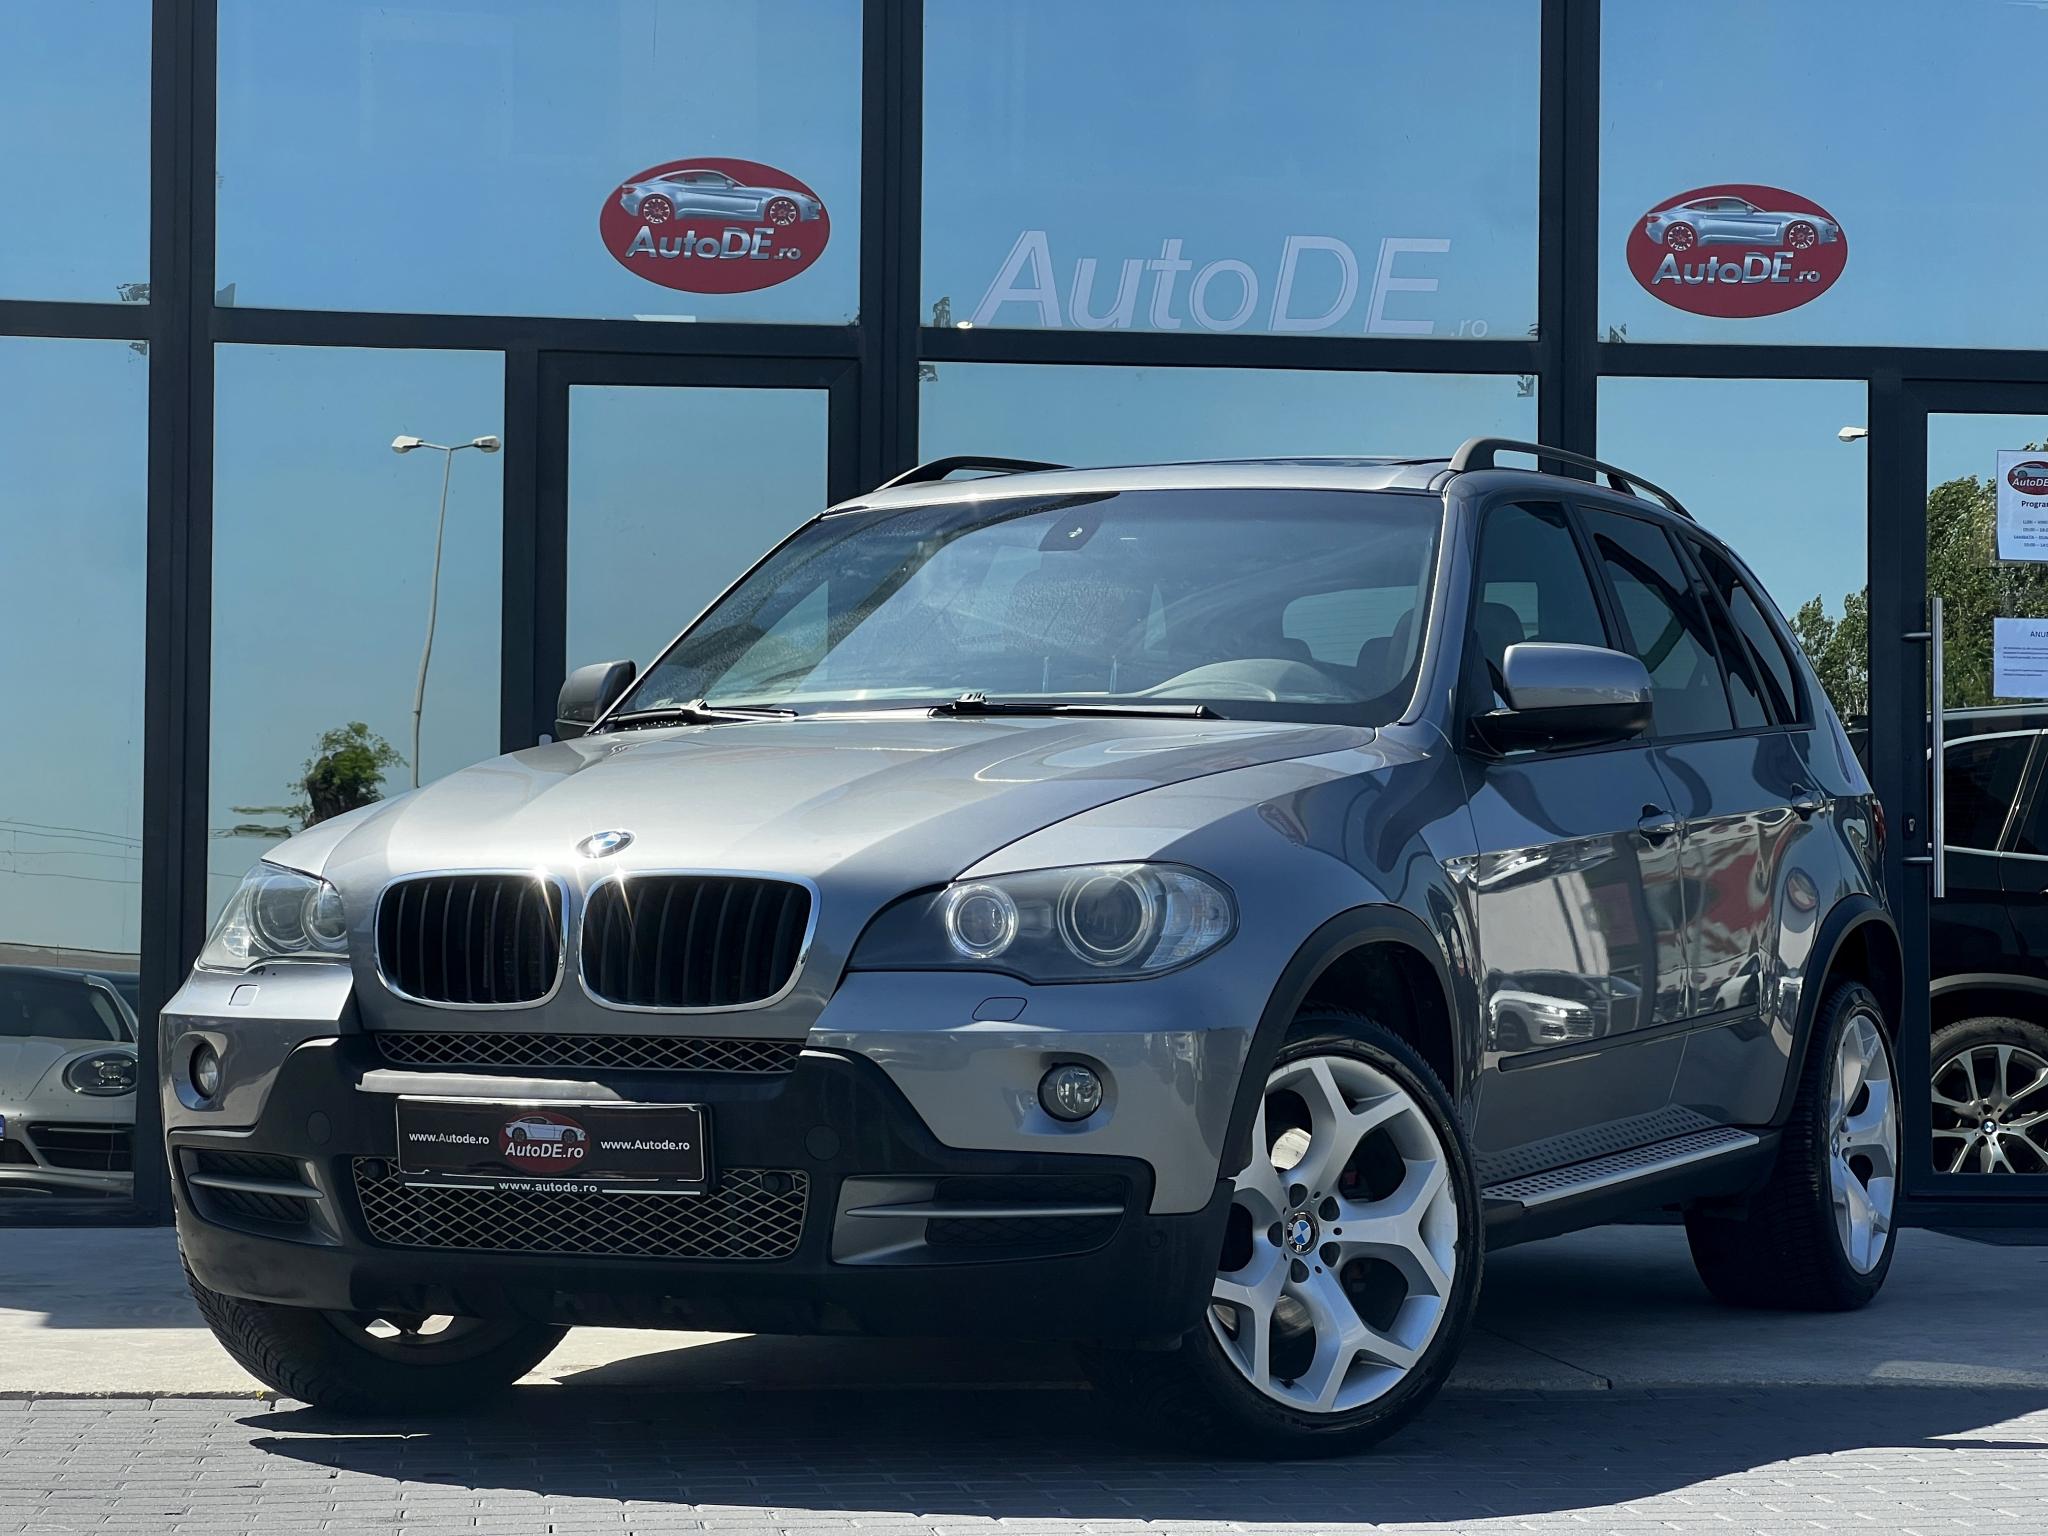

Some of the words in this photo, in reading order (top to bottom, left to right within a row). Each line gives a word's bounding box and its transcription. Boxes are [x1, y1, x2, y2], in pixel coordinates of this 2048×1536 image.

[408, 1132, 490, 1145] www.Autode.ro
[505, 1142, 584, 1158] AutoDE.ro
[600, 1139, 690, 1151] www.Autode.ro
[499, 1182, 598, 1193] www.autode.ro
